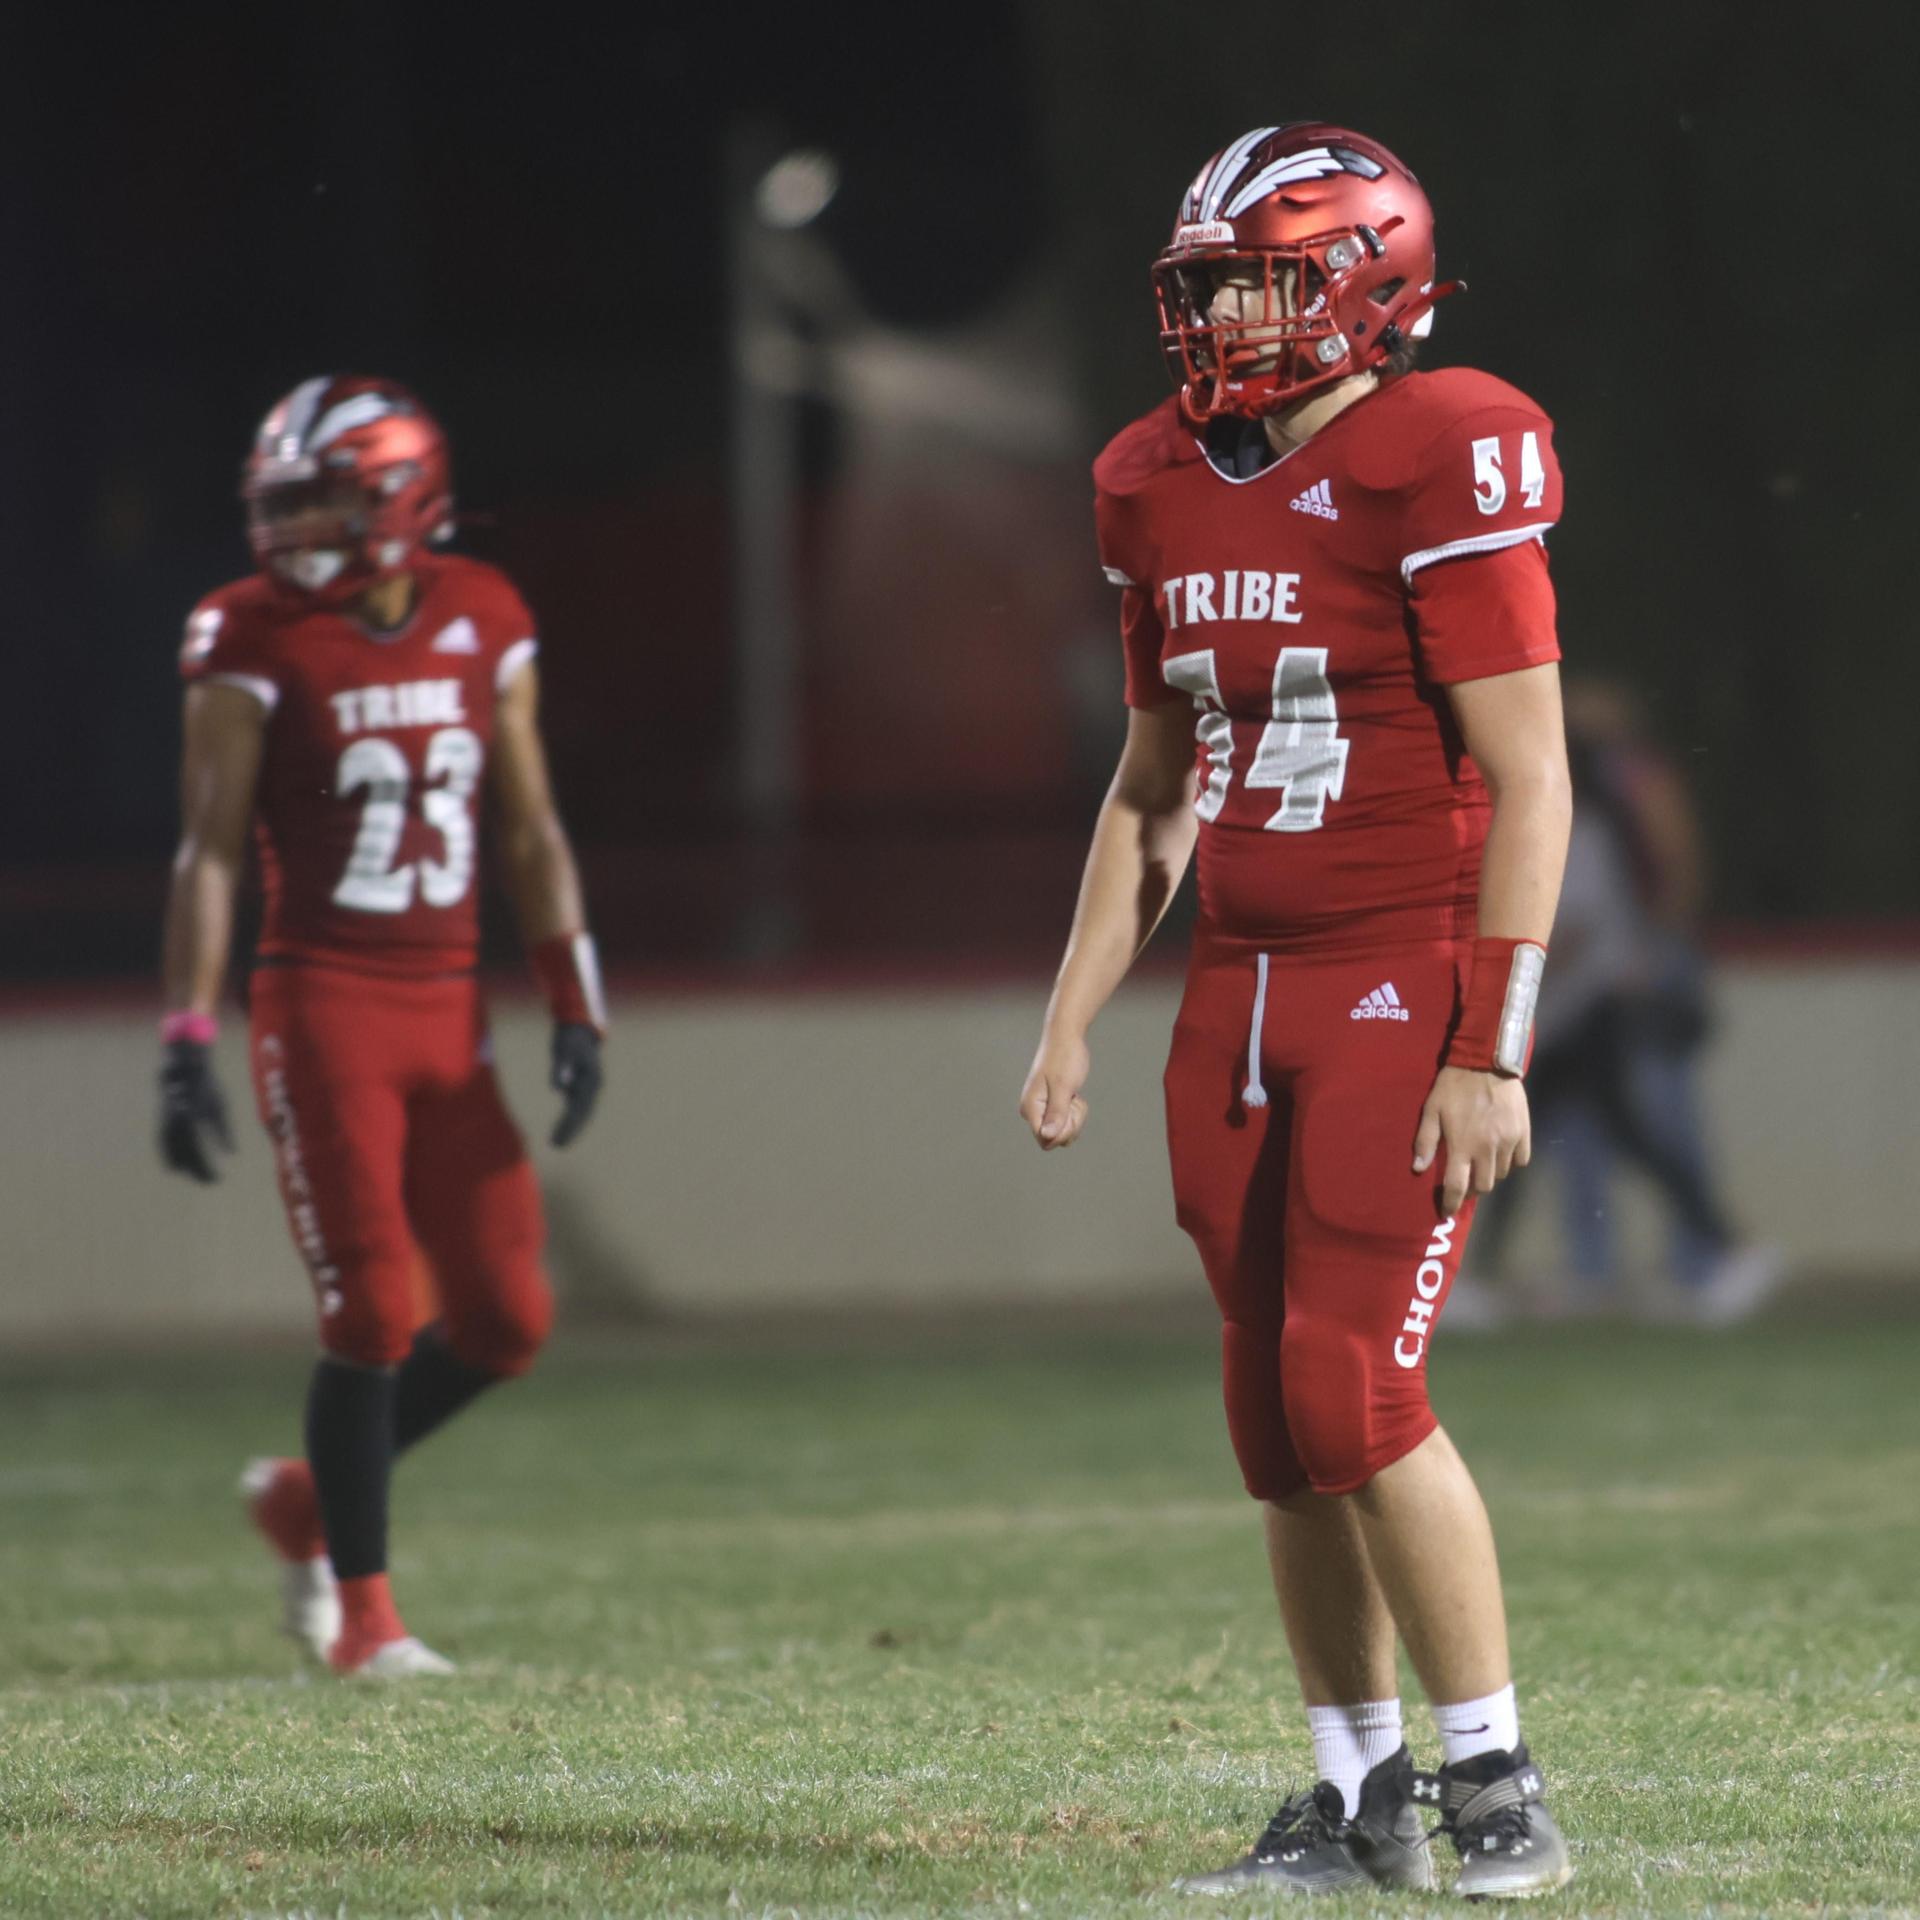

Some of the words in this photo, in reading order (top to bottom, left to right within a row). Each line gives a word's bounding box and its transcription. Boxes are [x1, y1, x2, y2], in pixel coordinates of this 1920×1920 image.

[1471, 431, 1546, 515] 54
[1289, 498, 1339, 521] adidas
[1162, 570, 1302, 630] TRIBE
[332, 727, 482, 914] 23
[1350, 1003, 1409, 1021] adidas
